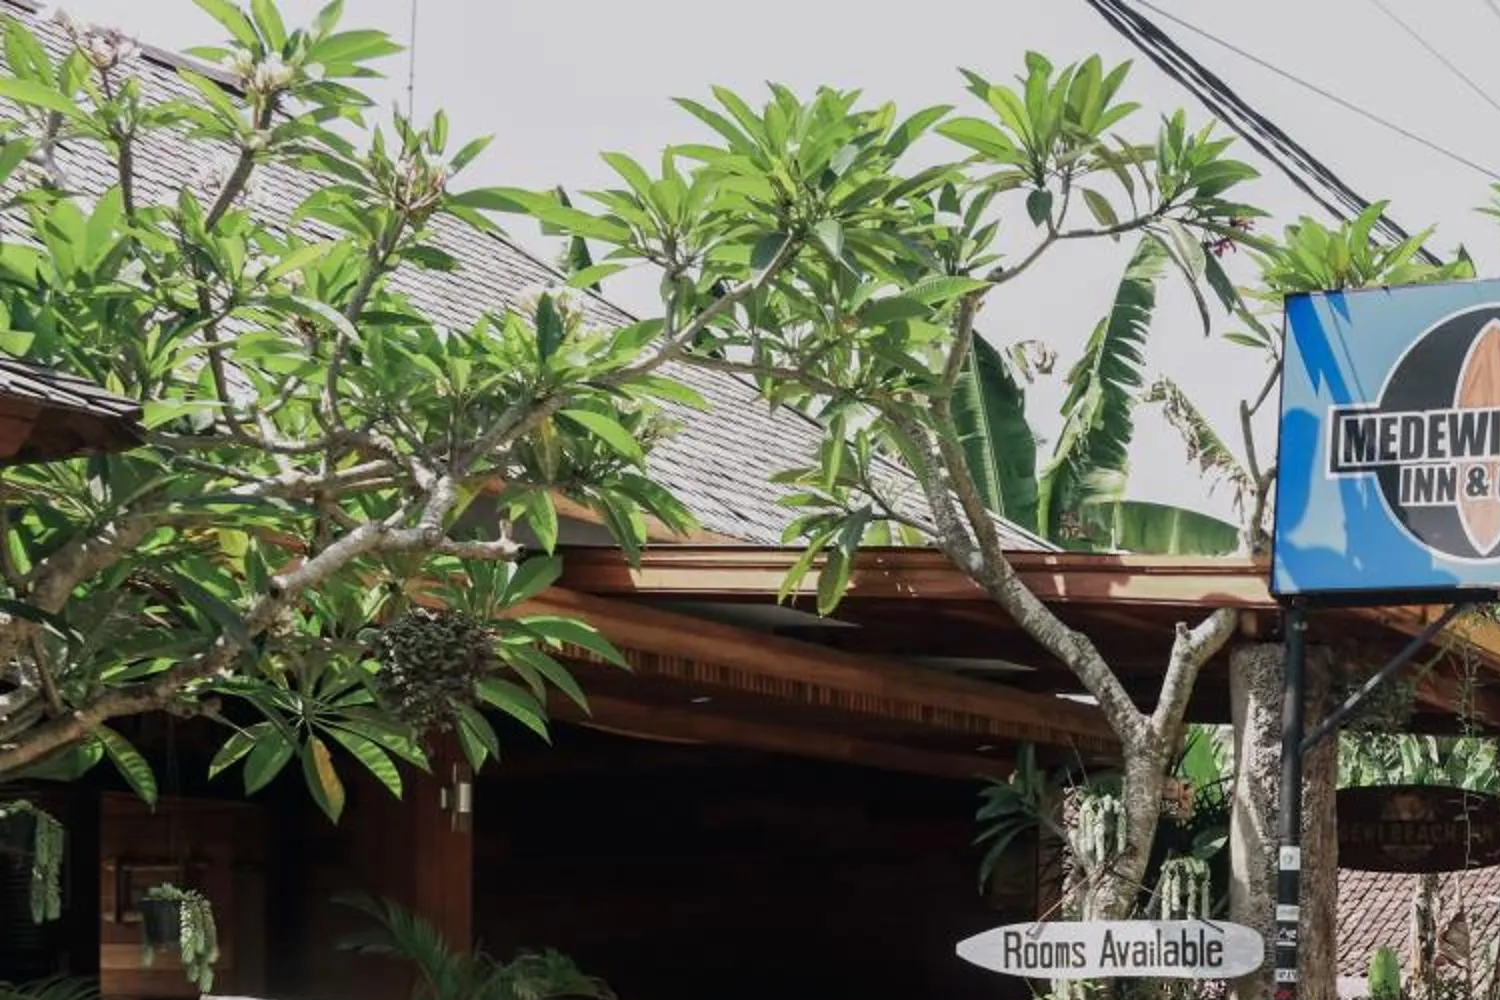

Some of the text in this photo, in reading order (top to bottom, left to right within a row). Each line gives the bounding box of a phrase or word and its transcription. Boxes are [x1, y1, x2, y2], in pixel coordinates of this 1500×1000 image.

[1343, 407, 1500, 462] MEDEWI
[1402, 464, 1456, 503] INN
[1465, 466, 1489, 498] &
[1004, 928, 1224, 969] Rooms Available
